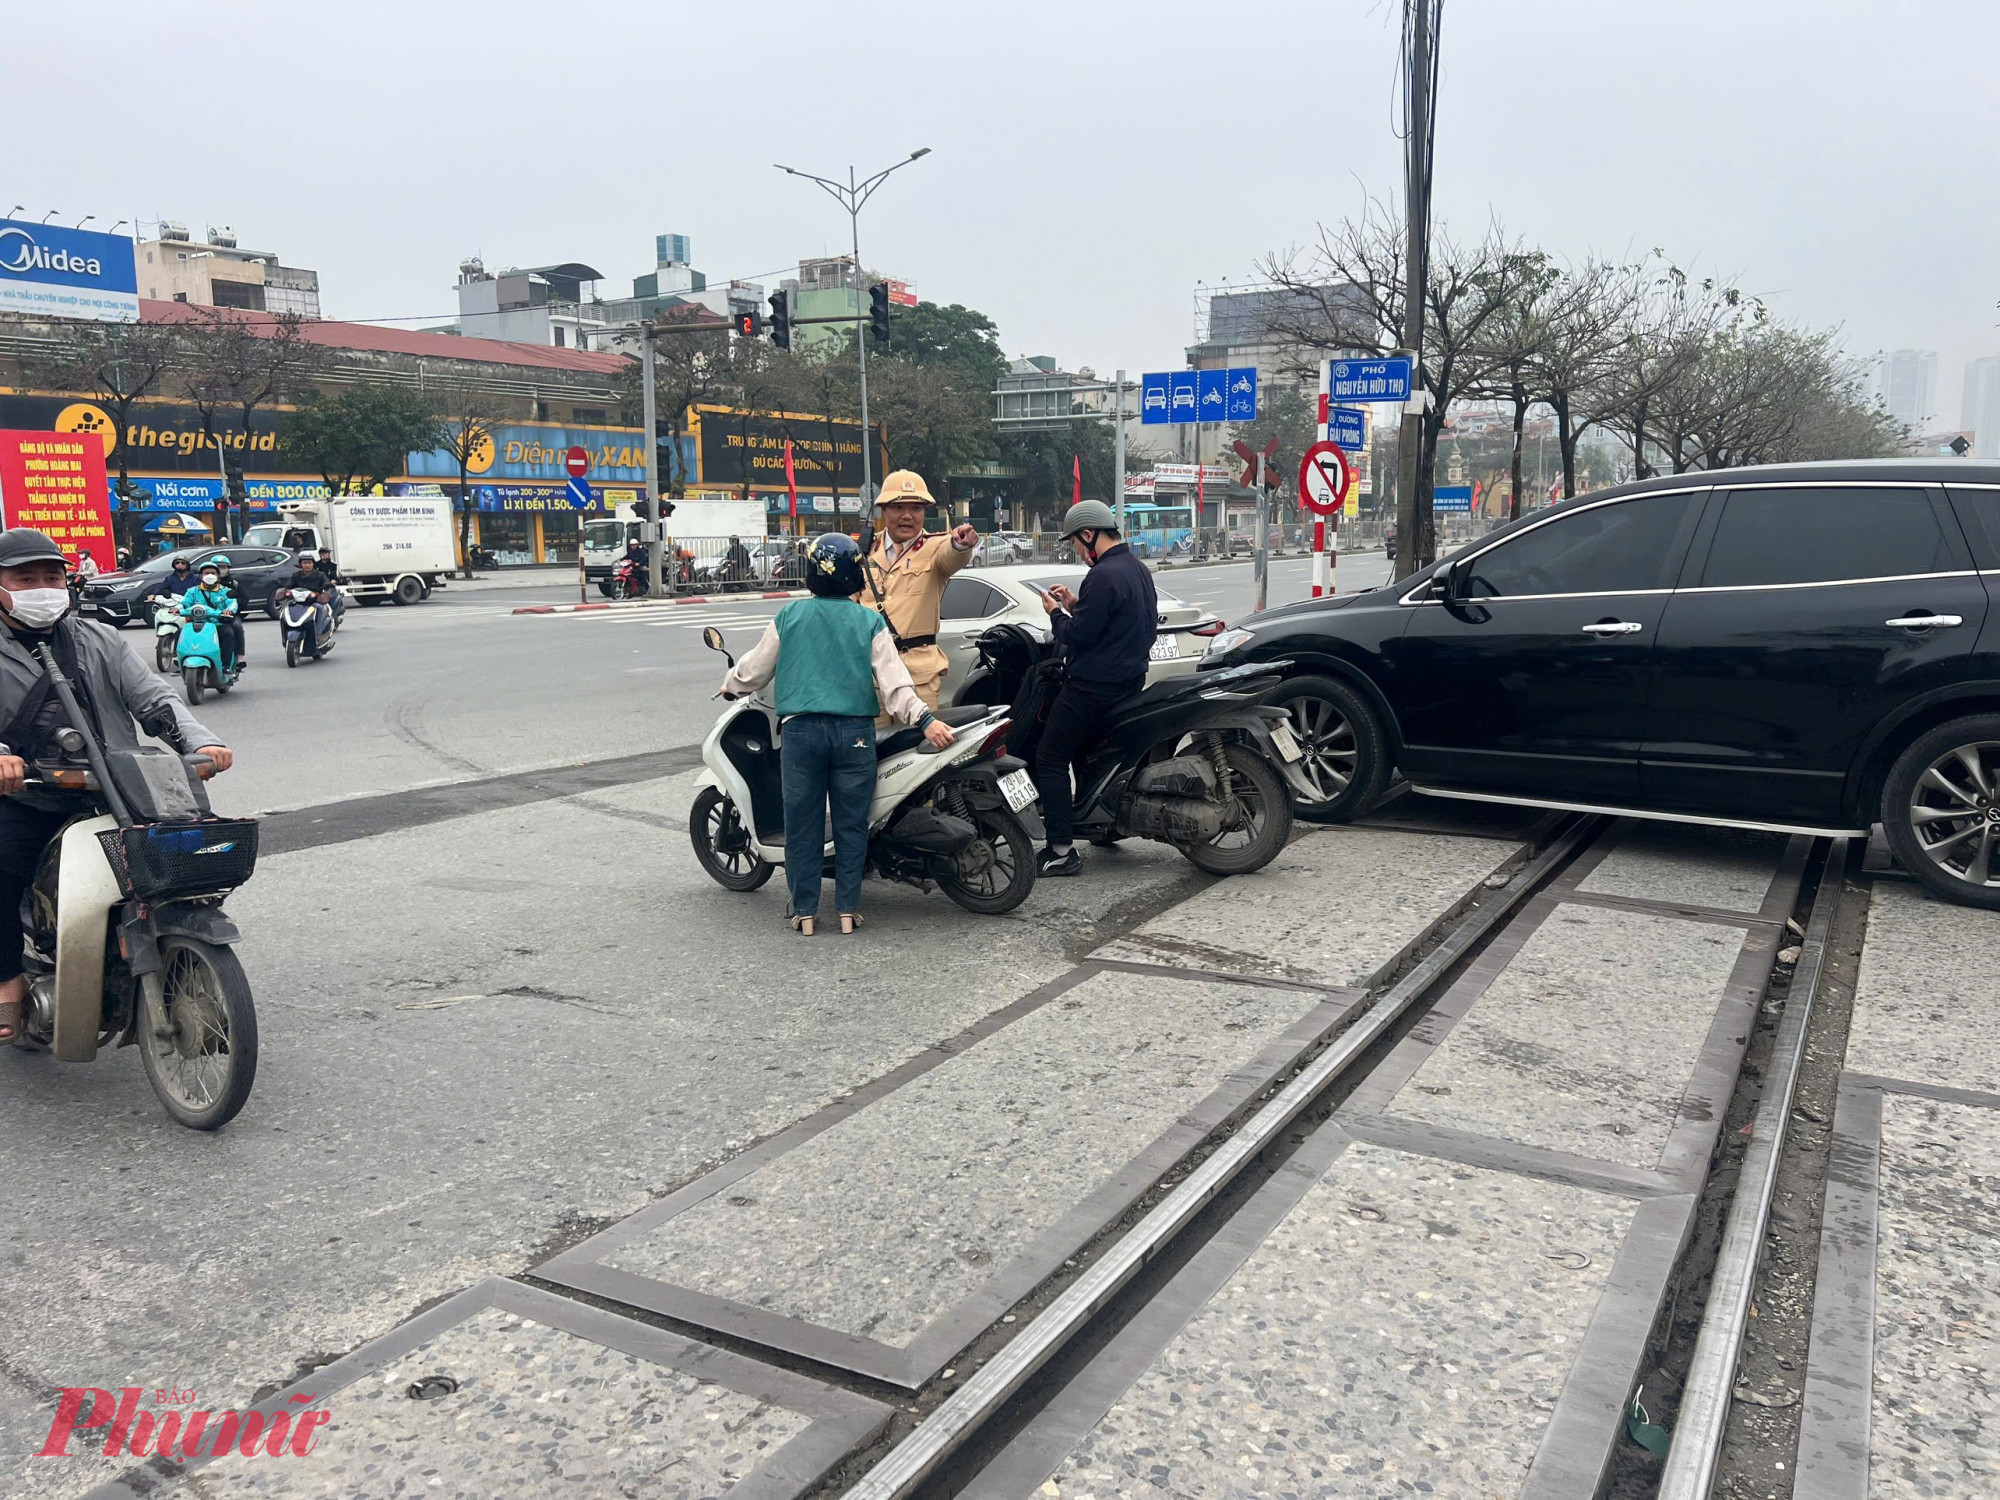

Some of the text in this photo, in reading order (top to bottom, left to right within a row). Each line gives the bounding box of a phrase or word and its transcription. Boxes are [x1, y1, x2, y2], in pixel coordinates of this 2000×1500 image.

[12, 244, 101, 275] Midea
[1362, 363, 1387, 374] PHỐ
[1336, 376, 1404, 396] NGUYỄN HỮU THỌ
[1330, 422, 1360, 444] GIẢI PHÓNG
[20, 440, 36, 454] ĐẢNG
[46, 442, 54, 454] VÀ
[54, 442, 71, 454] NHÂN
[72, 442, 84, 454] DÂN
[760, 435, 776, 449] ÂM
[840, 440, 862, 454] HÃNG
[502, 440, 554, 471] Điện
[752, 454, 766, 468] ĐỦ
[767, 455, 784, 468] CÁC
[792, 458, 821, 470] HƯƠNG
[25, 458, 82, 471] PHƯỜNG HOÀNG MAI
[24, 475, 86, 490] QUYẾT TÂM THỰC HIỆN
[156, 482, 208, 497] Nồi cơm
[28, 491, 48, 504] THẮNG
[58, 492, 78, 506] NHIỆM
[78, 494, 86, 506] VỤ
[250, 484, 274, 498] ĐẾN
[506, 488, 520, 498] lạnh
[350, 506, 366, 516] CÔNG
[376, 507, 391, 516] DƯỢC
[392, 504, 408, 515] PHẨM
[409, 506, 421, 515] TÂM
[504, 498, 513, 510] LÌ
[514, 498, 524, 510] XÌ
[526, 496, 544, 510] ĐẾN
[18, 508, 34, 520] PHÁT
[34, 507, 52, 520] TRIỂN
[52, 510, 66, 520] KINH
[67, 507, 74, 520] TẾ
[78, 508, 86, 520] XÃ
[51, 527, 66, 537] NINH
[70, 523, 86, 538] QUỐC
[86, 525, 106, 536] PHÒNG
[1150, 646, 1178, 658] 623.97
[1009, 783, 1036, 810] 863.19
